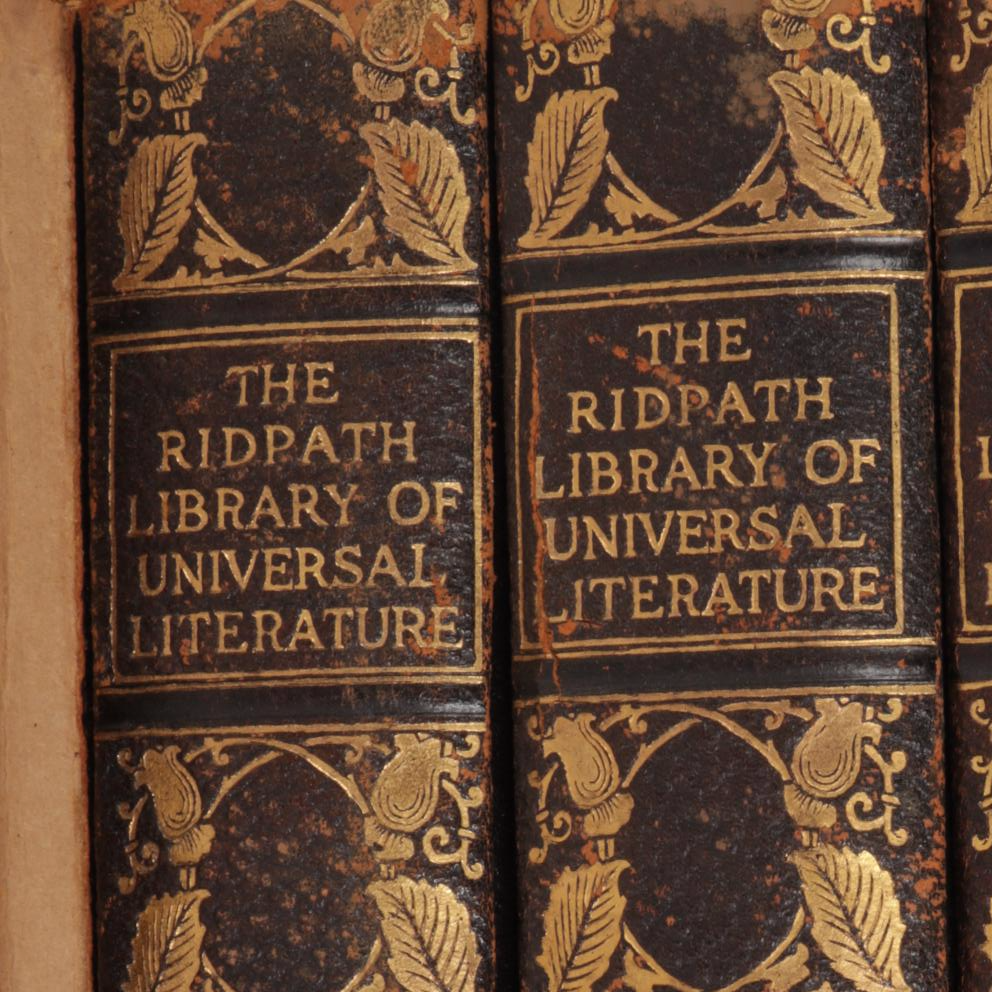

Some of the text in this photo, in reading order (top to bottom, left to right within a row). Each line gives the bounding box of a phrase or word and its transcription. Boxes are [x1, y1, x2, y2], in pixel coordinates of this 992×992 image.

[638, 318, 752, 366] THE
[226, 361, 339, 406] THE
[567, 377, 834, 434] RIDPATH
[157, 420, 417, 472] RIDPATH
[535, 438, 882, 500] LIBRARY OF
[127, 481, 464, 537] LIBRARY OF
[544, 503, 866, 561] UNIVERSAL
[138, 543, 445, 596] UNIVERSAL
[131, 606, 464, 658] LITERATURE
